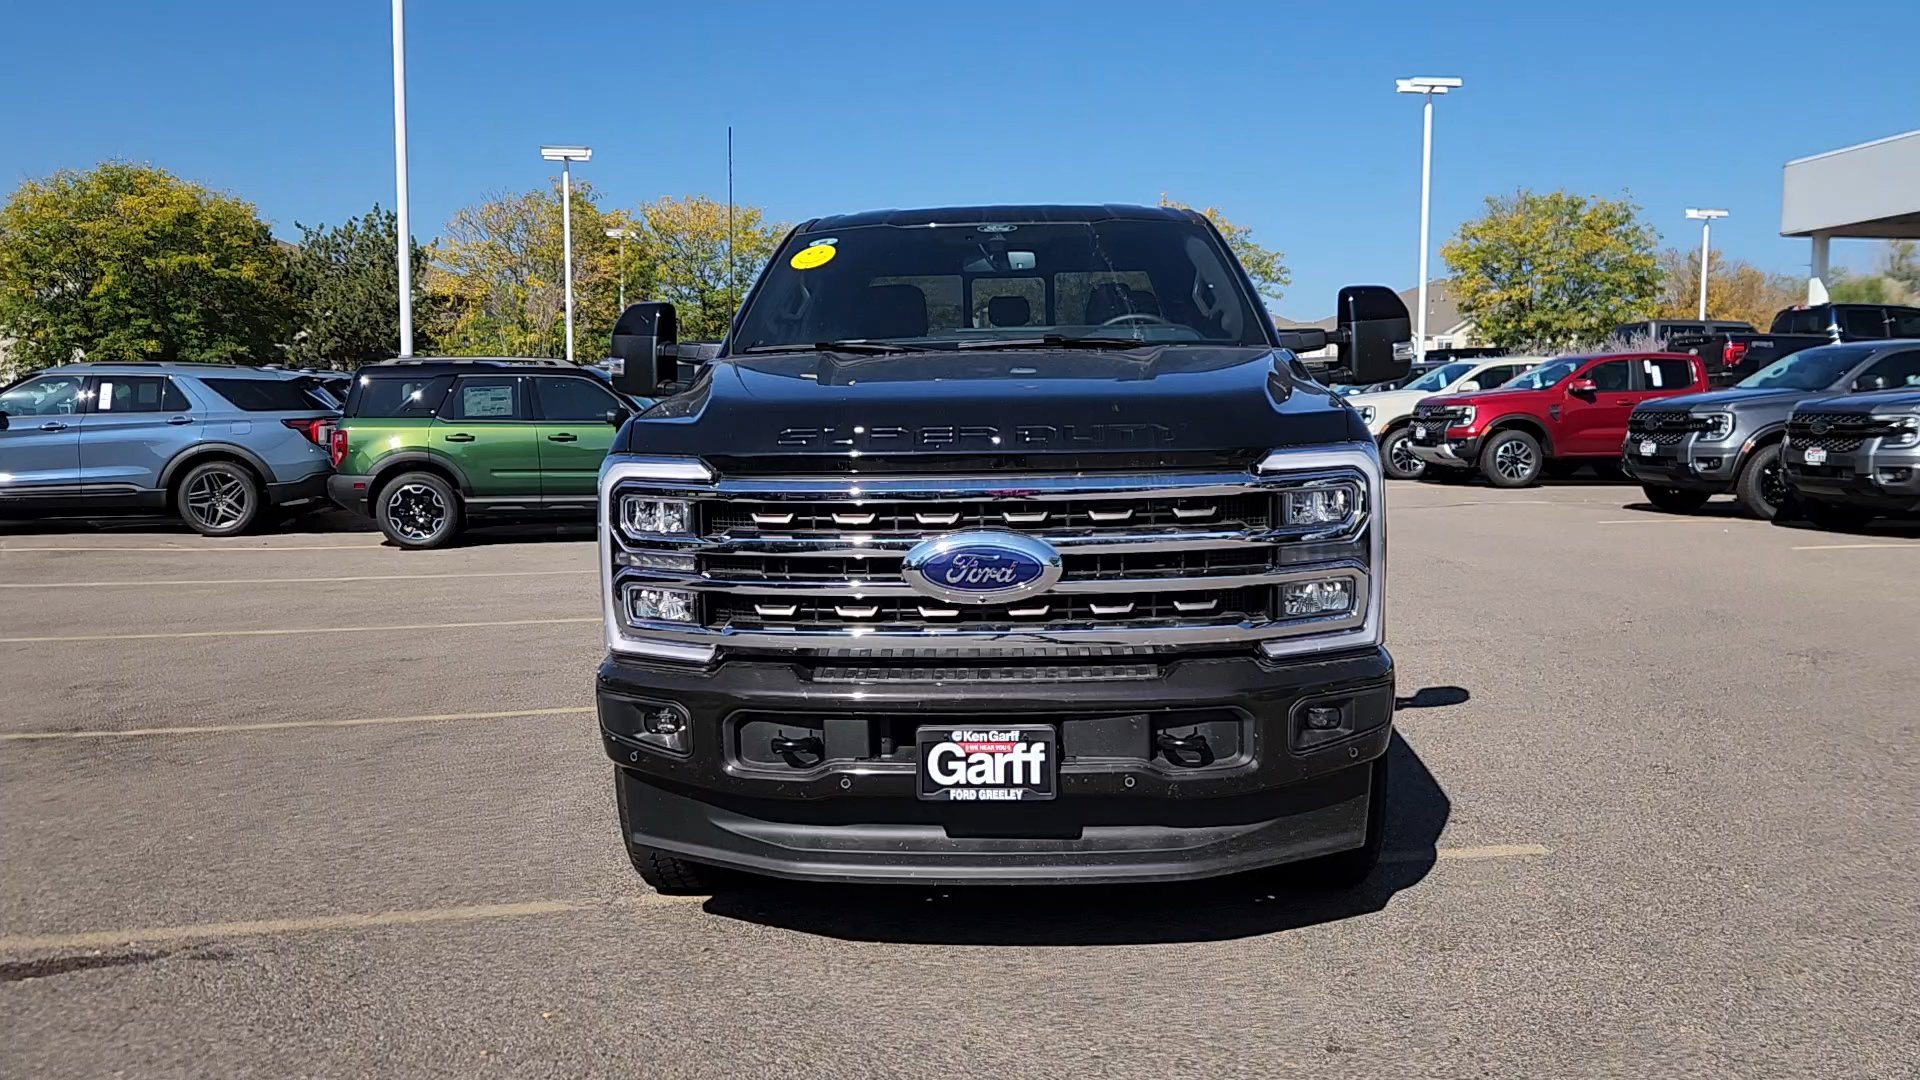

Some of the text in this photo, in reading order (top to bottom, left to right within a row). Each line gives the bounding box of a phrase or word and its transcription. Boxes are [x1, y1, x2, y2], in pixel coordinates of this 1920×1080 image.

[777, 424, 1177, 445] SUPER DUTY
[945, 553, 1017, 584] Ford
[963, 731, 1020, 742] Ken Garff
[927, 742, 1046, 785] Garff
[950, 790, 1023, 800] FORD GREELEY
